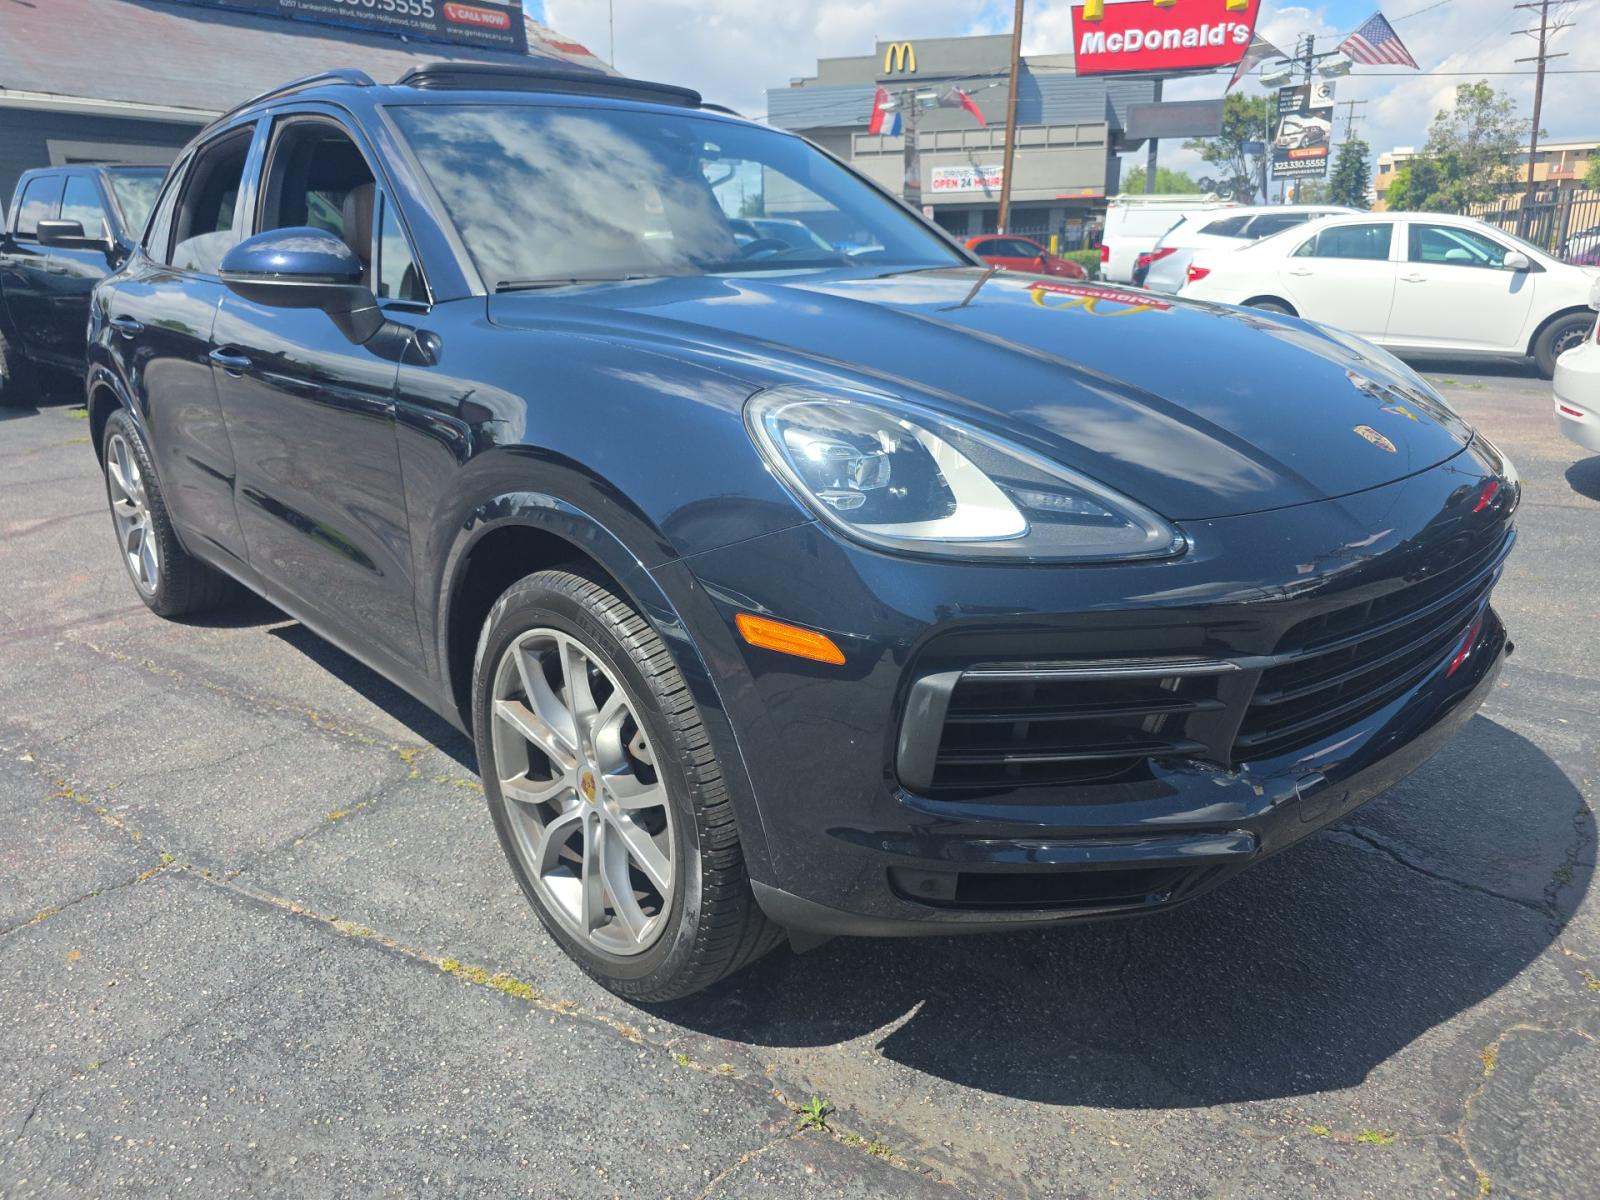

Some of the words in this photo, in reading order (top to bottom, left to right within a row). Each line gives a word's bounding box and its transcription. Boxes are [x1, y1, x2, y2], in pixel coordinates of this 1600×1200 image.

[334, 0, 434, 18] .5555
[458, 9, 480, 21] CALL
[481, 14, 504, 25] NOW
[1079, 22, 1249, 55] McDonald's
[1274, 159, 1326, 171] 323.330.5555
[933, 179, 957, 189] OPEN
[960, 178, 972, 188] 24
